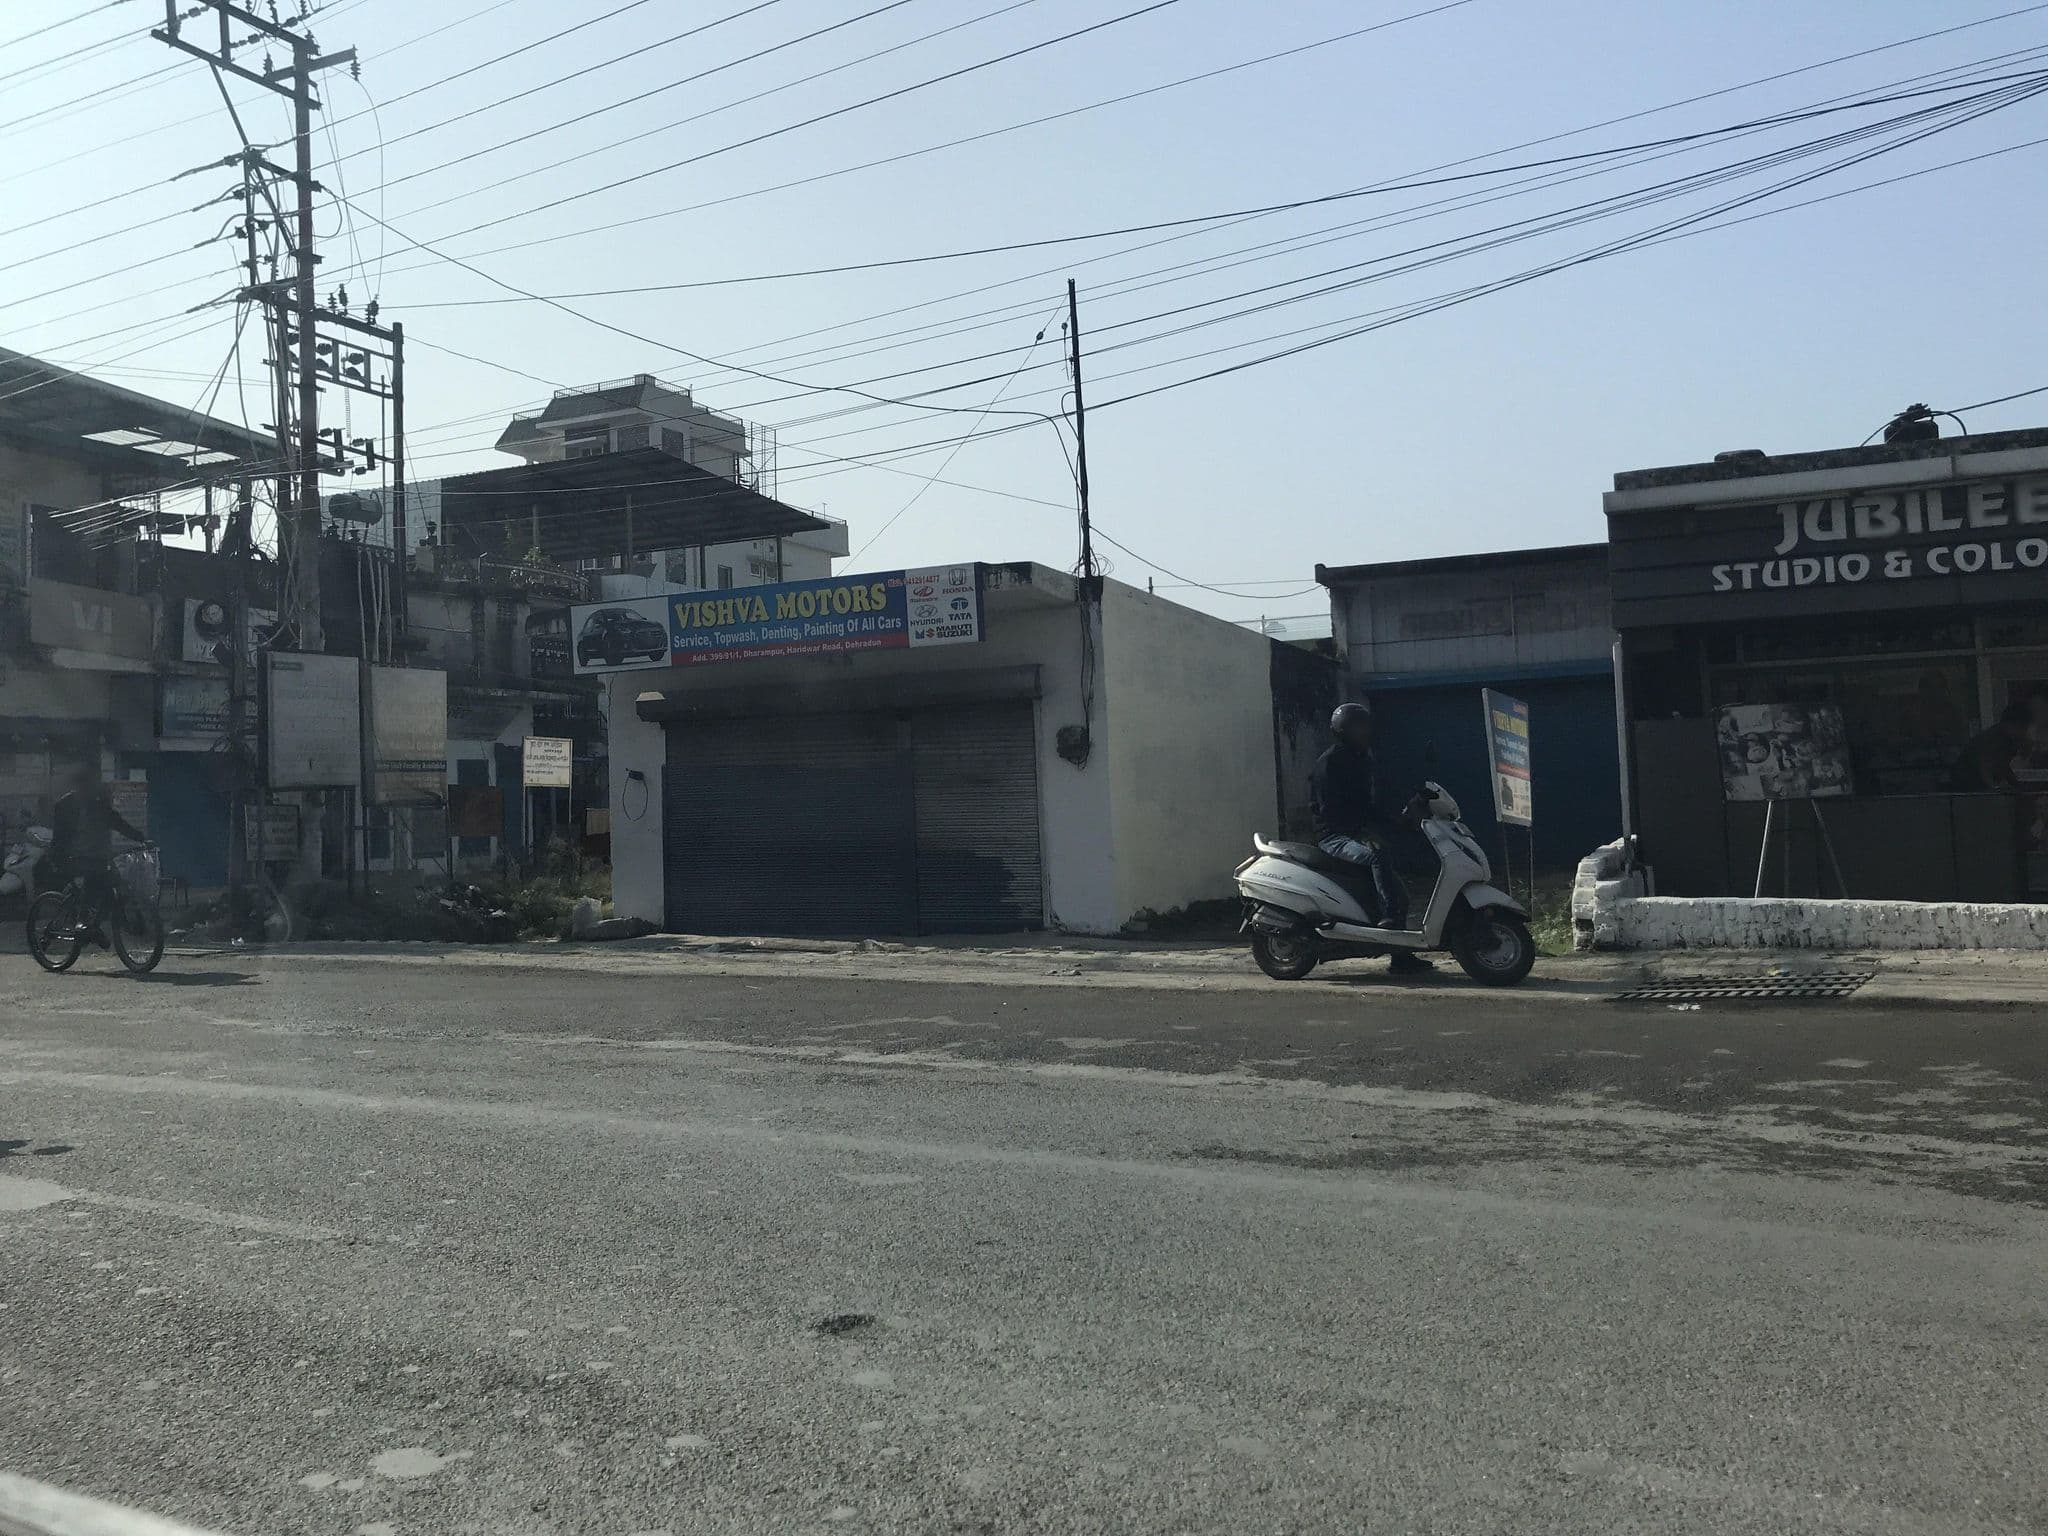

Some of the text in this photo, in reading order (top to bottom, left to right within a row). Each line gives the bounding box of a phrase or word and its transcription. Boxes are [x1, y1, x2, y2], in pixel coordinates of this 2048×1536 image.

[1774, 476, 2048, 555] JUBILEE
[1711, 538, 2048, 591] STUDIO & COLO
[942, 586, 975, 595] HONDA
[674, 582, 887, 630] VISHVA MOTORS
[948, 612, 972, 621] TATA
[674, 615, 902, 649] Service, Topwash, Denting, Painting Of All Cars
[936, 630, 973, 638] SUZUKI
[743, 647, 785, 659] Dharampur,
[786, 643, 820, 655] Haridwar
[822, 641, 844, 652] Road,
[845, 638, 882, 649] Dehradun
